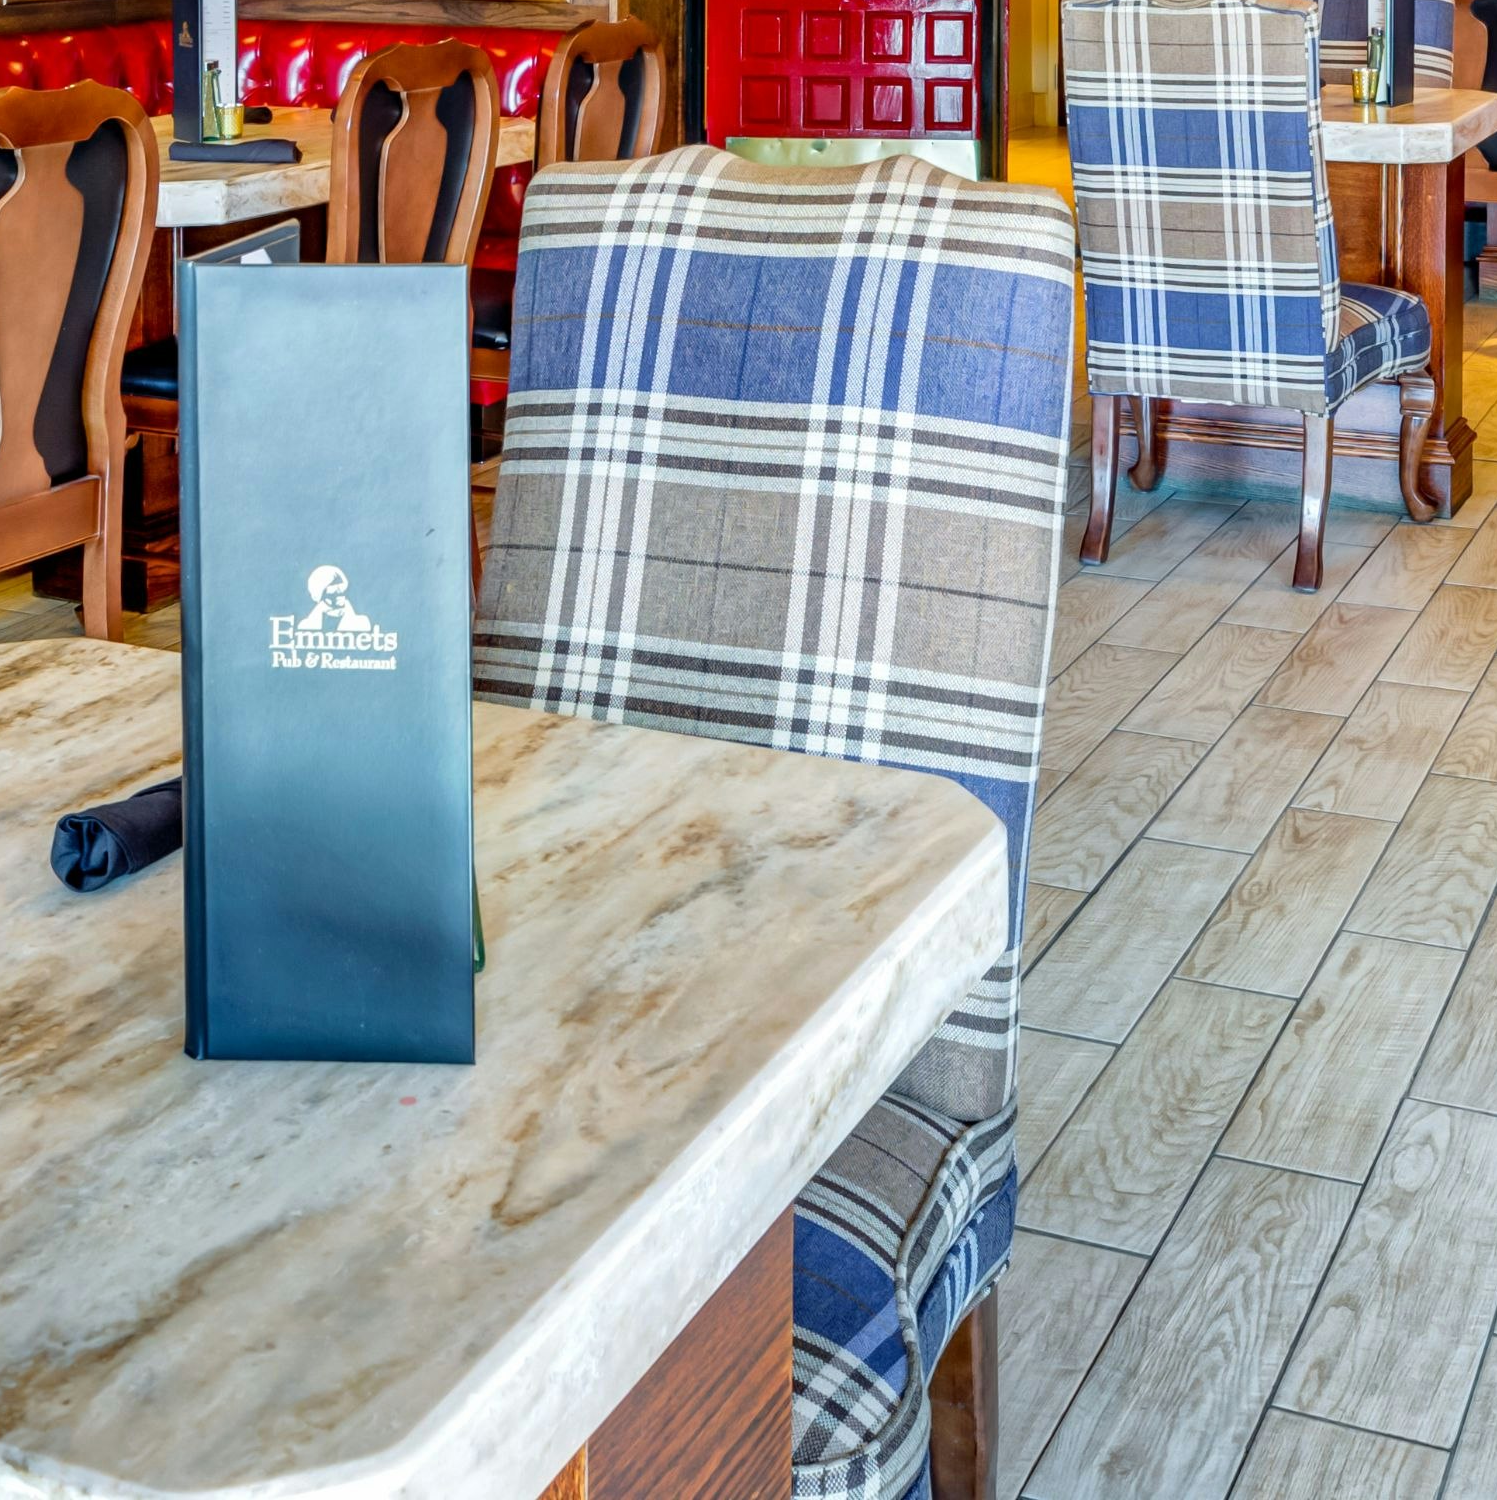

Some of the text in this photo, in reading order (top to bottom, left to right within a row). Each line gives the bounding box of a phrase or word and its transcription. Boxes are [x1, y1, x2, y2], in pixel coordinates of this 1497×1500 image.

[269, 614, 398, 652] Emmets
[272, 650, 397, 670] Pub & Restaurant
